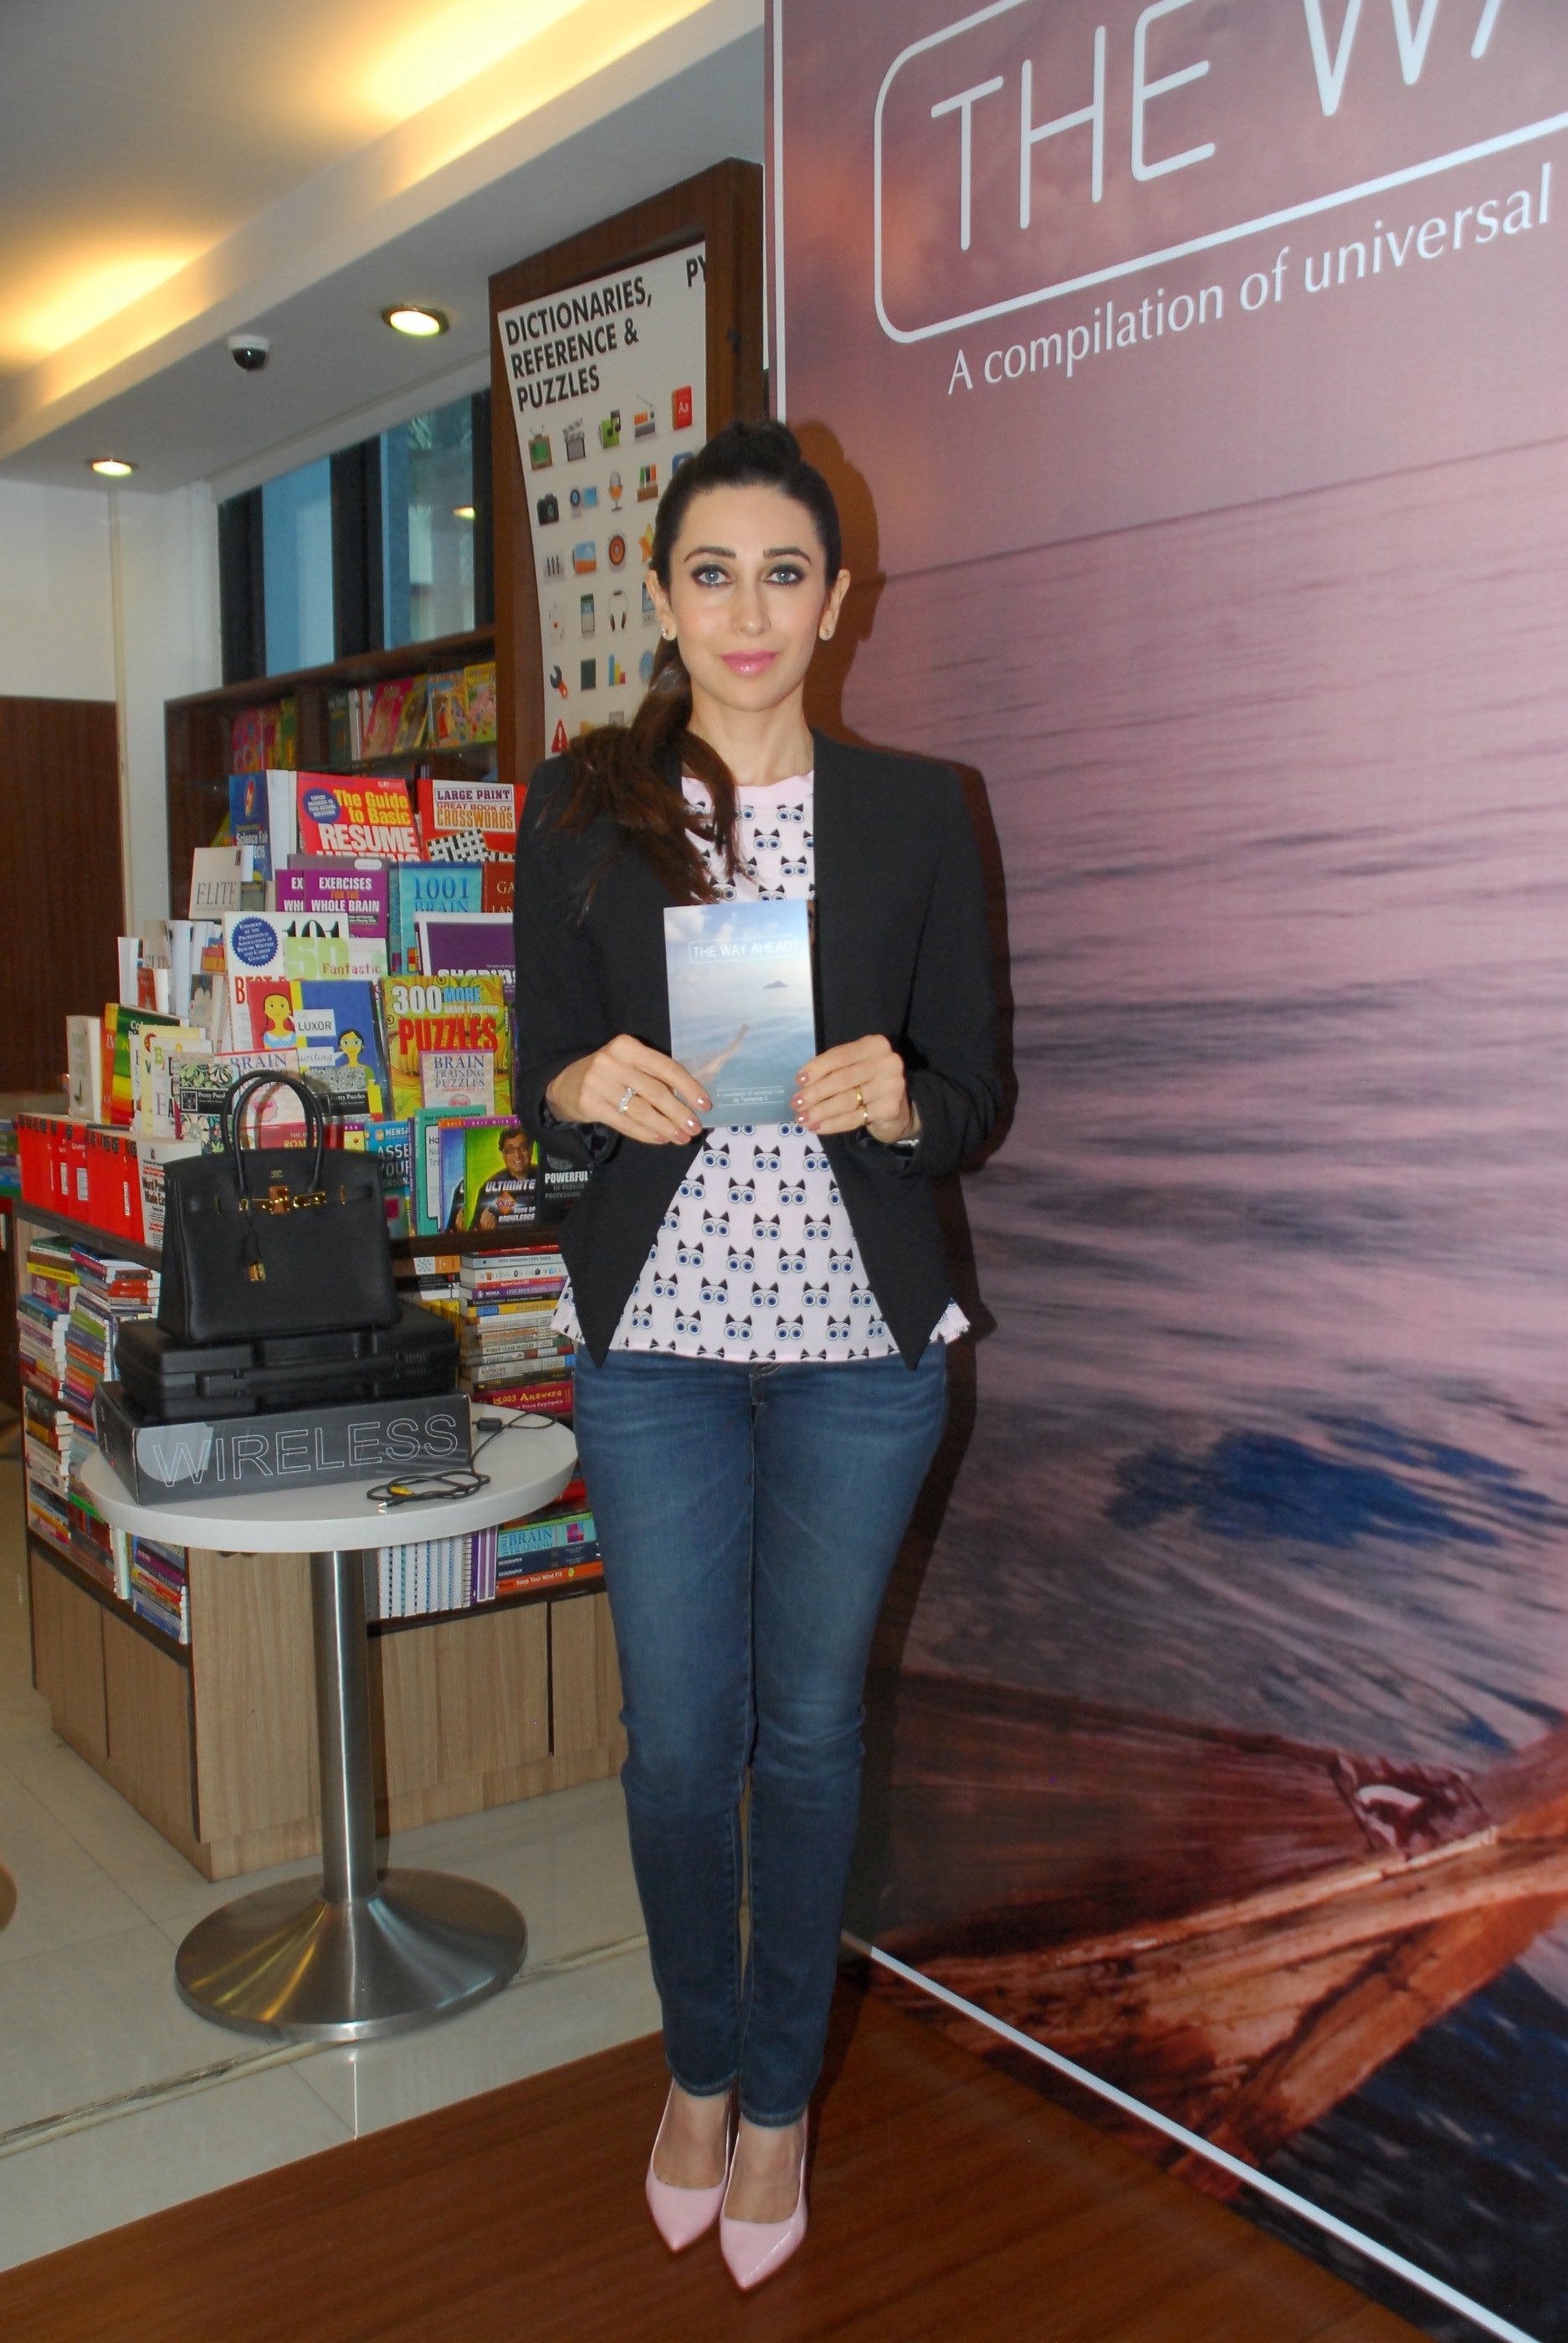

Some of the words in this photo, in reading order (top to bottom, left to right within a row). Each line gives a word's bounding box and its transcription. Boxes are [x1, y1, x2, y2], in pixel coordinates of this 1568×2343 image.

[930, 0, 1216, 251] THE
[947, 349, 974, 395] A
[984, 288, 1223, 382] compilation
[1240, 248, 1289, 310] of
[1304, 162, 1551, 294] universal
[505, 276, 653, 346] DICTIONARIES,
[510, 322, 617, 379] REFERENCE
[623, 317, 638, 346] &
[516, 364, 601, 413] PUZZLES
[679, 401, 689, 413] Aa
[334, 789, 361, 807] The
[365, 792, 408, 809] Guide
[436, 789, 474, 801] LARGE
[476, 789, 510, 800] PRINT
[436, 802, 469, 810] GREAT
[470, 802, 497, 811] BOOK
[349, 808, 365, 824] to
[369, 808, 411, 826] Basic
[436, 809, 514, 829] CROSSWORDS
[318, 823, 418, 853] RESUME
[291, 877, 304, 890] EX
[319, 877, 372, 890] EXERCISES
[413, 876, 469, 899] 1001
[197, 881, 237, 905] ELITE
[331, 890, 344, 900] FOR
[346, 890, 360, 900] THE
[311, 900, 346, 912] WHOLE
[348, 900, 380, 912] BRAIN
[693, 946, 716, 959] THE
[720, 944, 746, 957] WAY
[751, 941, 792, 954] AHEAD
[285, 937, 350, 981] 50
[323, 963, 382, 975] Fantastic
[392, 986, 442, 1015] 300
[443, 987, 481, 1002] MORE
[298, 1021, 332, 1031] LUXOR
[398, 1018, 498, 1054] PUZZLES
[298, 1053, 332, 1064] writing
[433, 1054, 484, 1069] BRAIN
[435, 1069, 484, 1077] TRAINING
[435, 1078, 484, 1088] PUZZLES
[545, 1171, 588, 1184] POWERFUL
[485, 1179, 535, 1192] ULTIMATE
[499, 1213, 535, 1223] KNOWLEDGE
[520, 1390, 562, 1402] Answers
[152, 1414, 459, 1488] WIRELESS
[510, 1526, 552, 1546] BRAIN
[498, 1557, 522, 1566] GEOGRAPHY
[498, 1568, 522, 1577] GEOGRAPHY
